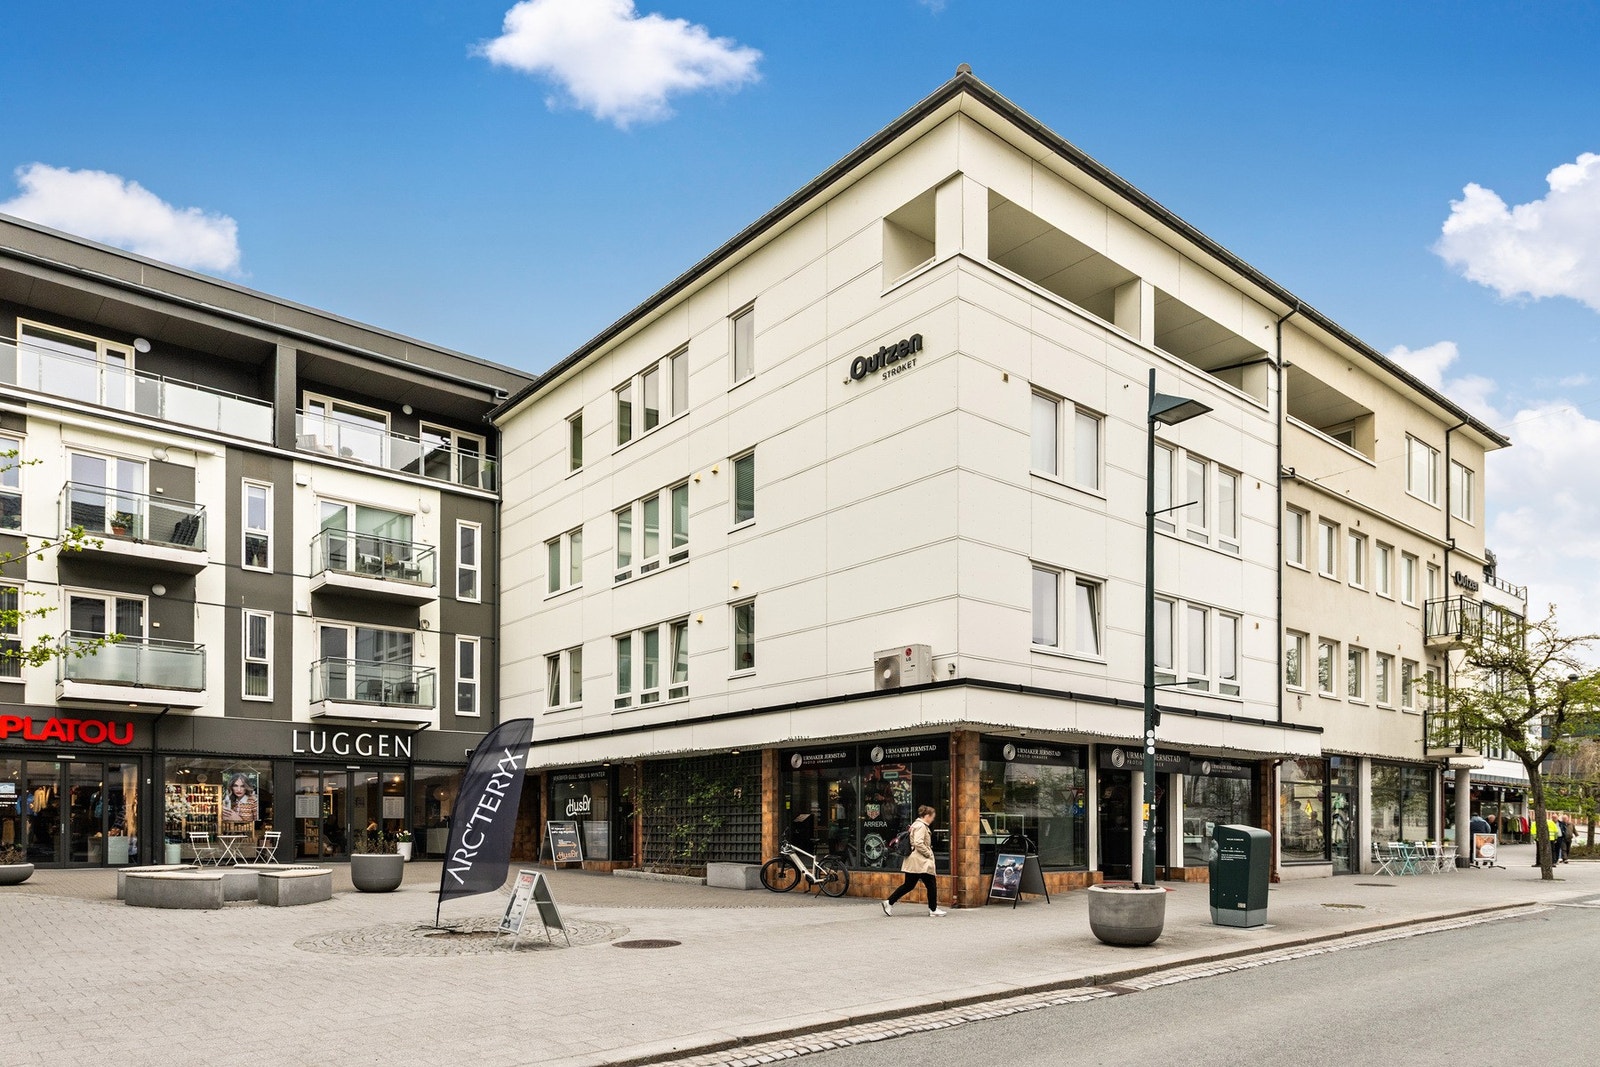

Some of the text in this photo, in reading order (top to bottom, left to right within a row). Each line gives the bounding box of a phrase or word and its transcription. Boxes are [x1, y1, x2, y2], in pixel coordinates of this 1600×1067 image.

[850, 333, 923, 381] Outzen
[882, 358, 917, 380] STRØKET
[0, 716, 134, 745] PLATOU
[293, 729, 411, 758] LUGGEN
[885, 744, 937, 755] URMAKER JERMSTAD
[1017, 747, 1039, 755] URMAKER
[1155, 753, 1181, 763] ERMSTAD
